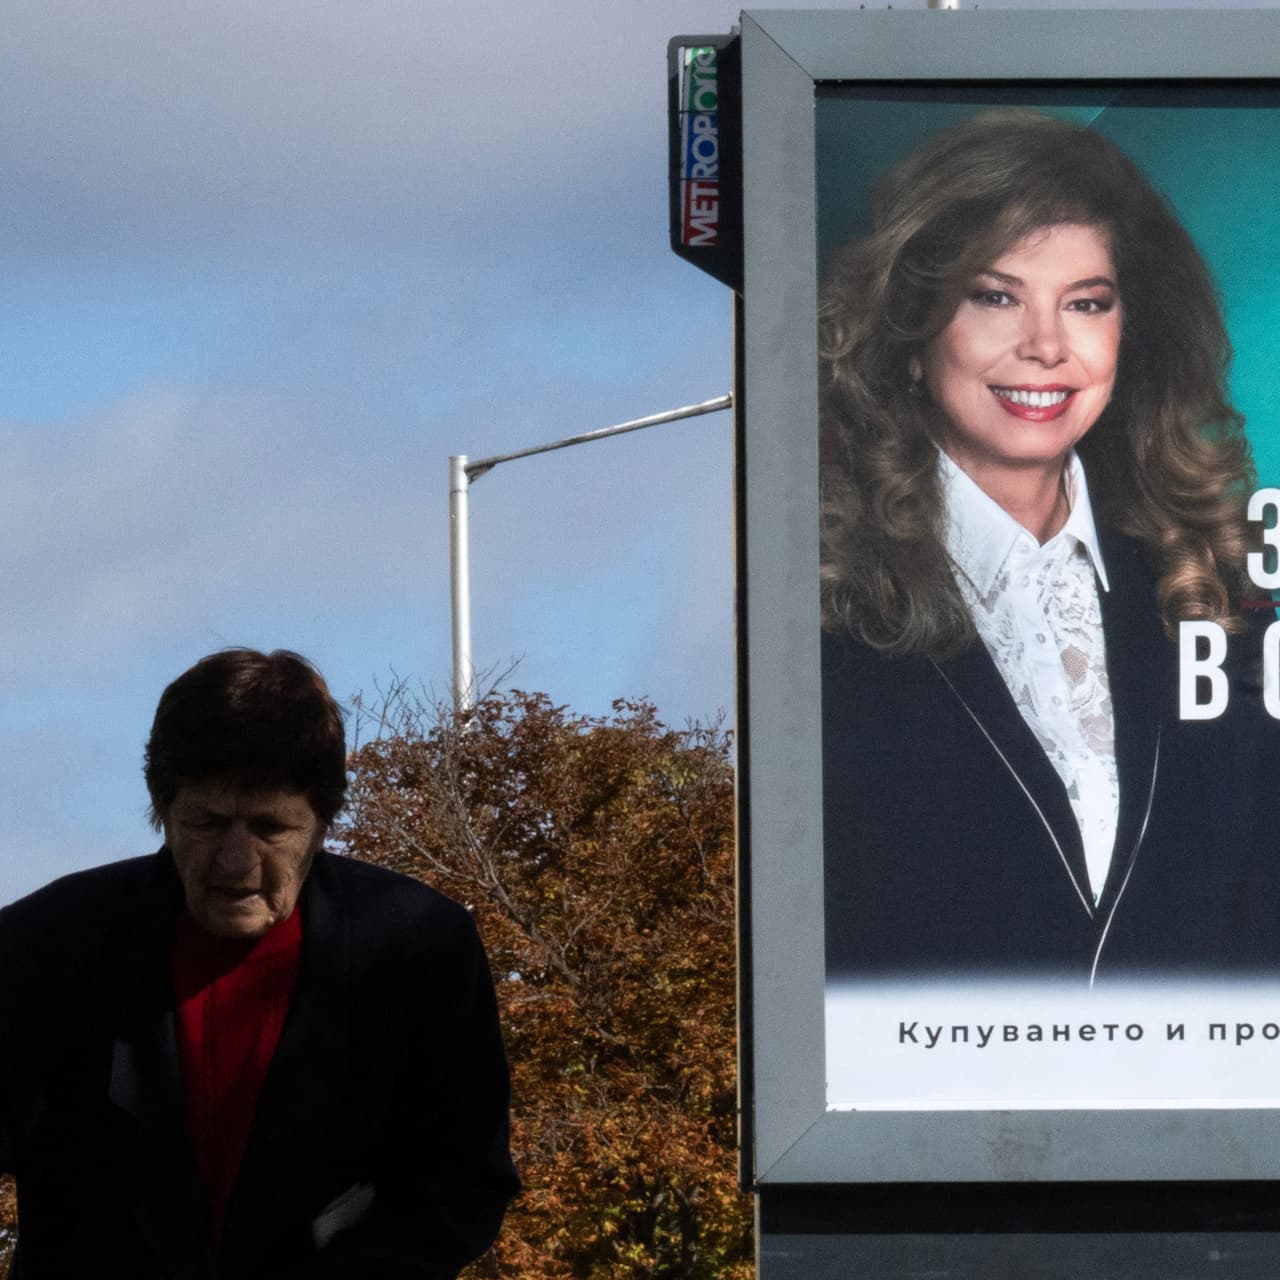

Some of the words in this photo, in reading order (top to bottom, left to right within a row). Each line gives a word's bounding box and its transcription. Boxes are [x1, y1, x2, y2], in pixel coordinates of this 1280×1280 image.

[1179, 620, 1229, 720] В
[899, 1021, 1145, 1049] Купуването
[1167, 1023, 1186, 1041] и
